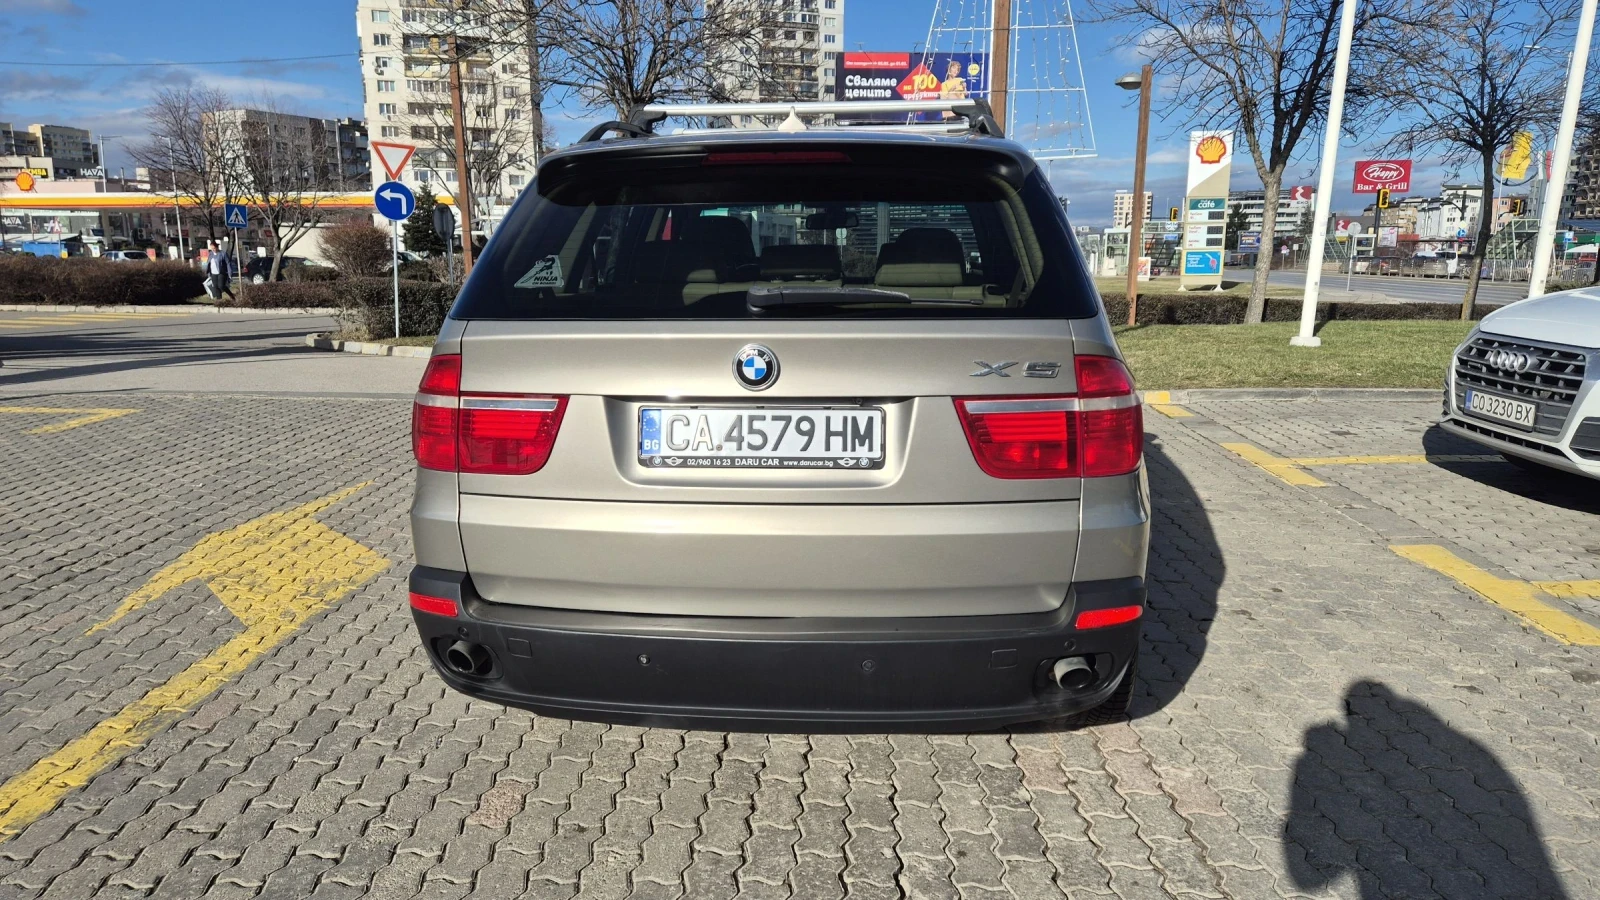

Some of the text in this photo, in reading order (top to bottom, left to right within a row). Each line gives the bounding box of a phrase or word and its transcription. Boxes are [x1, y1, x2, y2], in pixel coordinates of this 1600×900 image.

[845, 75, 897, 86] Сваляме
[912, 73, 938, 89] 100
[845, 88, 892, 98] цените
[1368, 167, 1400, 179] Happy
[1376, 182, 1383, 190] &
[1386, 182, 1407, 190] Grill
[1197, 200, 1215, 208] café
[1486, 397, 1513, 418] 3230
[1515, 404, 1532, 423] BX
[666, 414, 874, 452] CA 4579 HM
[643, 439, 660, 450] BG
[735, 458, 760, 466] DARU
[761, 458, 779, 466] CAR
[783, 459, 833, 467] www.darucar.bg
